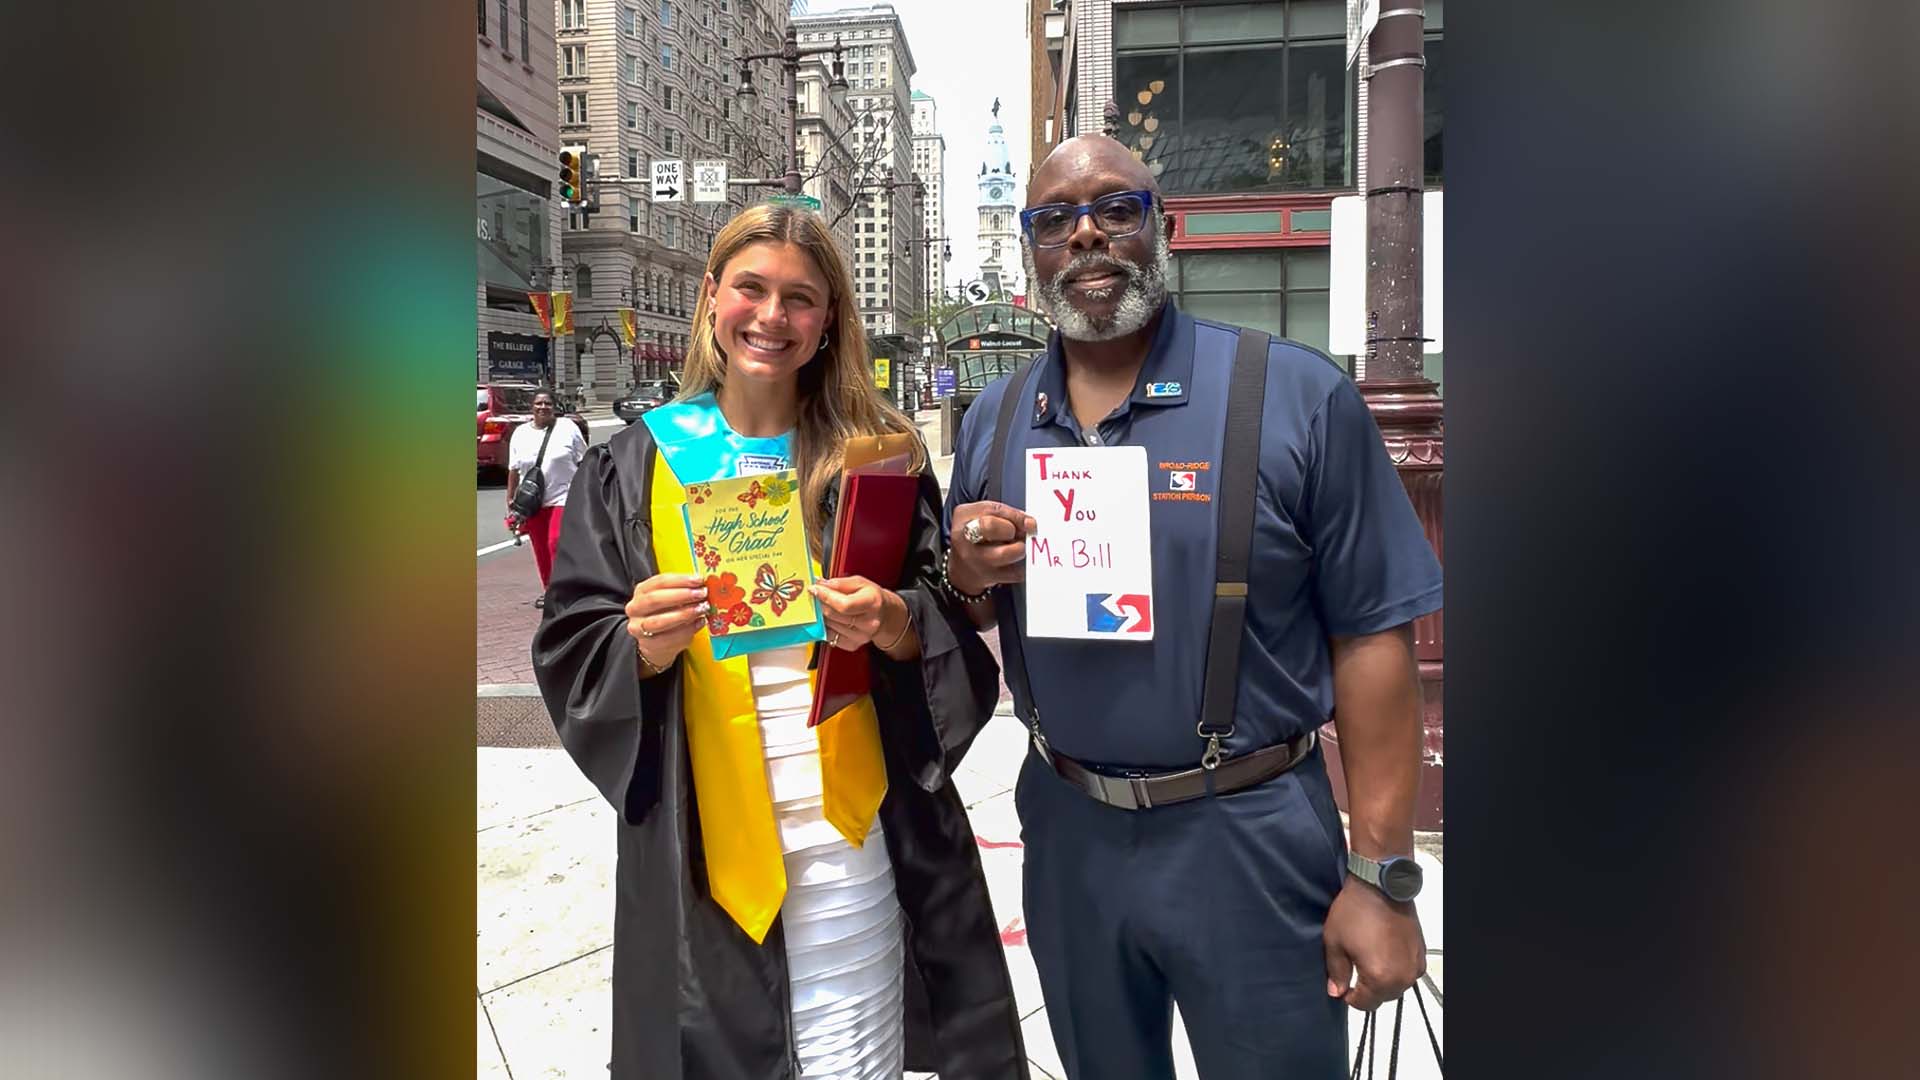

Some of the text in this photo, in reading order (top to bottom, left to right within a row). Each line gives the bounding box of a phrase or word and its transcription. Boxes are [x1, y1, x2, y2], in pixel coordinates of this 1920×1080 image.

[656, 163, 678, 174] ONE
[656, 174, 679, 185] WAY
[493, 341, 504, 350] THE
[1032, 453, 1092, 480] THANK
[1053, 488, 1096, 521] YOU
[1152, 492, 1181, 501] STATION
[704, 508, 790, 543] High School
[728, 526, 784, 554] Grad
[1071, 538, 1111, 569] Bill
